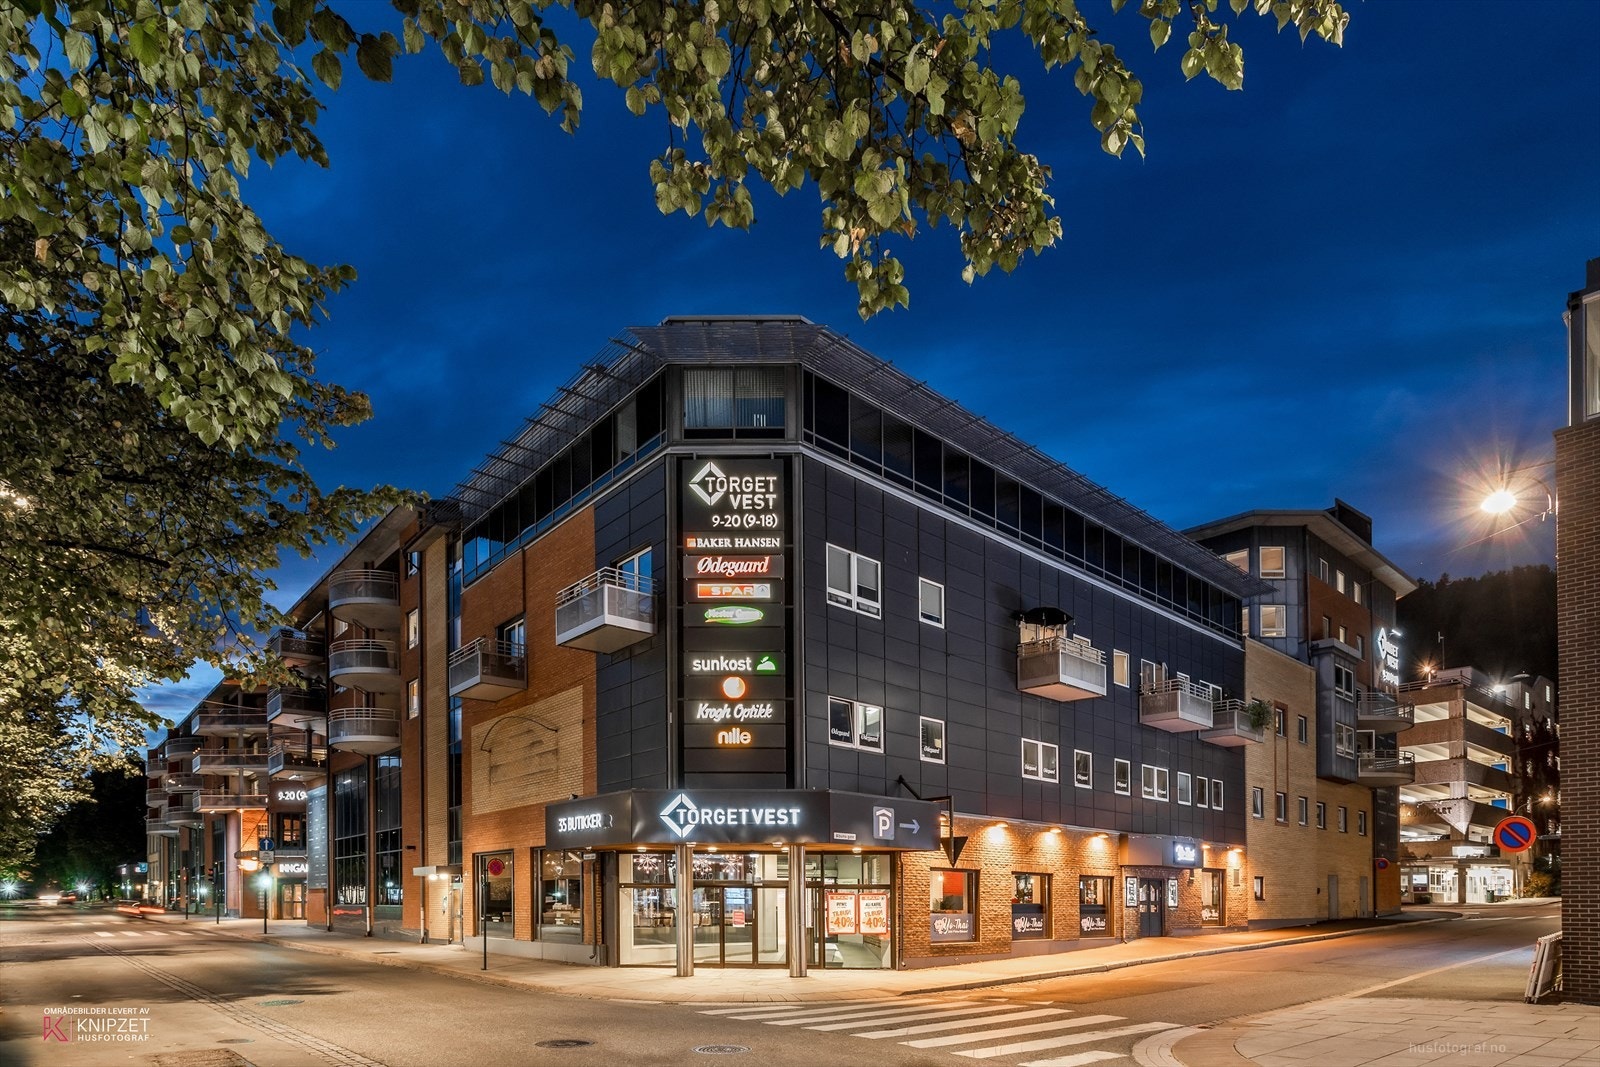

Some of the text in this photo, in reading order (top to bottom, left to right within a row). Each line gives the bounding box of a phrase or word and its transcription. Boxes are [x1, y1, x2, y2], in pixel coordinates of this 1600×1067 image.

[705, 477, 777, 493] TORGET
[730, 494, 777, 510] VEST
[712, 513, 778, 528] 9-20 (9-18)
[697, 538, 780, 548] BAKER HANSEN
[697, 556, 770, 577] Ødegaard
[711, 586, 754, 596] SPAR
[692, 656, 752, 671] sunkost
[697, 703, 773, 722] Krogh Optikk
[718, 728, 751, 744] nille
[278, 791, 295, 800] 9-20
[676, 808, 800, 825] TORGET VEST
[558, 818, 567, 832] 35
[830, 917, 854, 928] -40%
[862, 917, 886, 928] -40%
